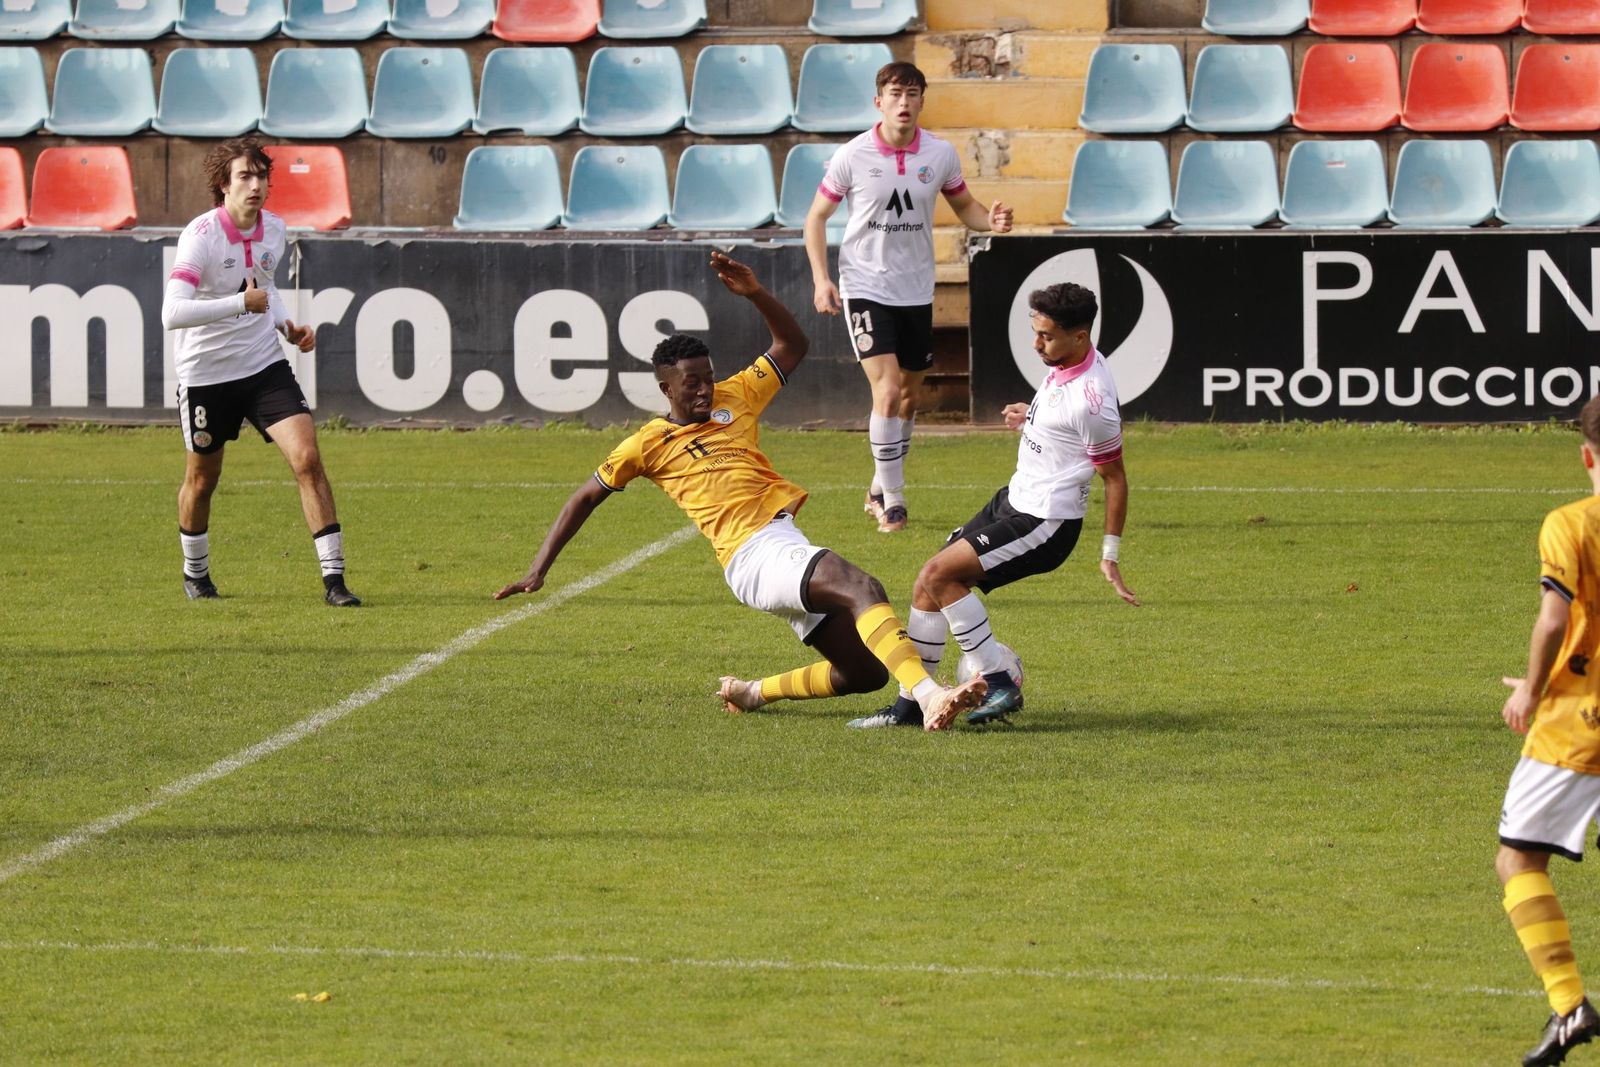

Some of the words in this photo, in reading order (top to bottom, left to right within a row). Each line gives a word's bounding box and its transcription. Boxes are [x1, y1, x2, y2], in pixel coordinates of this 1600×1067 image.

[868, 221, 924, 234] Medyarthros
[1303, 247, 1600, 369] PAN
[0, 246, 710, 412] mro.es
[852, 310, 874, 336] 21
[194, 405, 208, 428] 8
